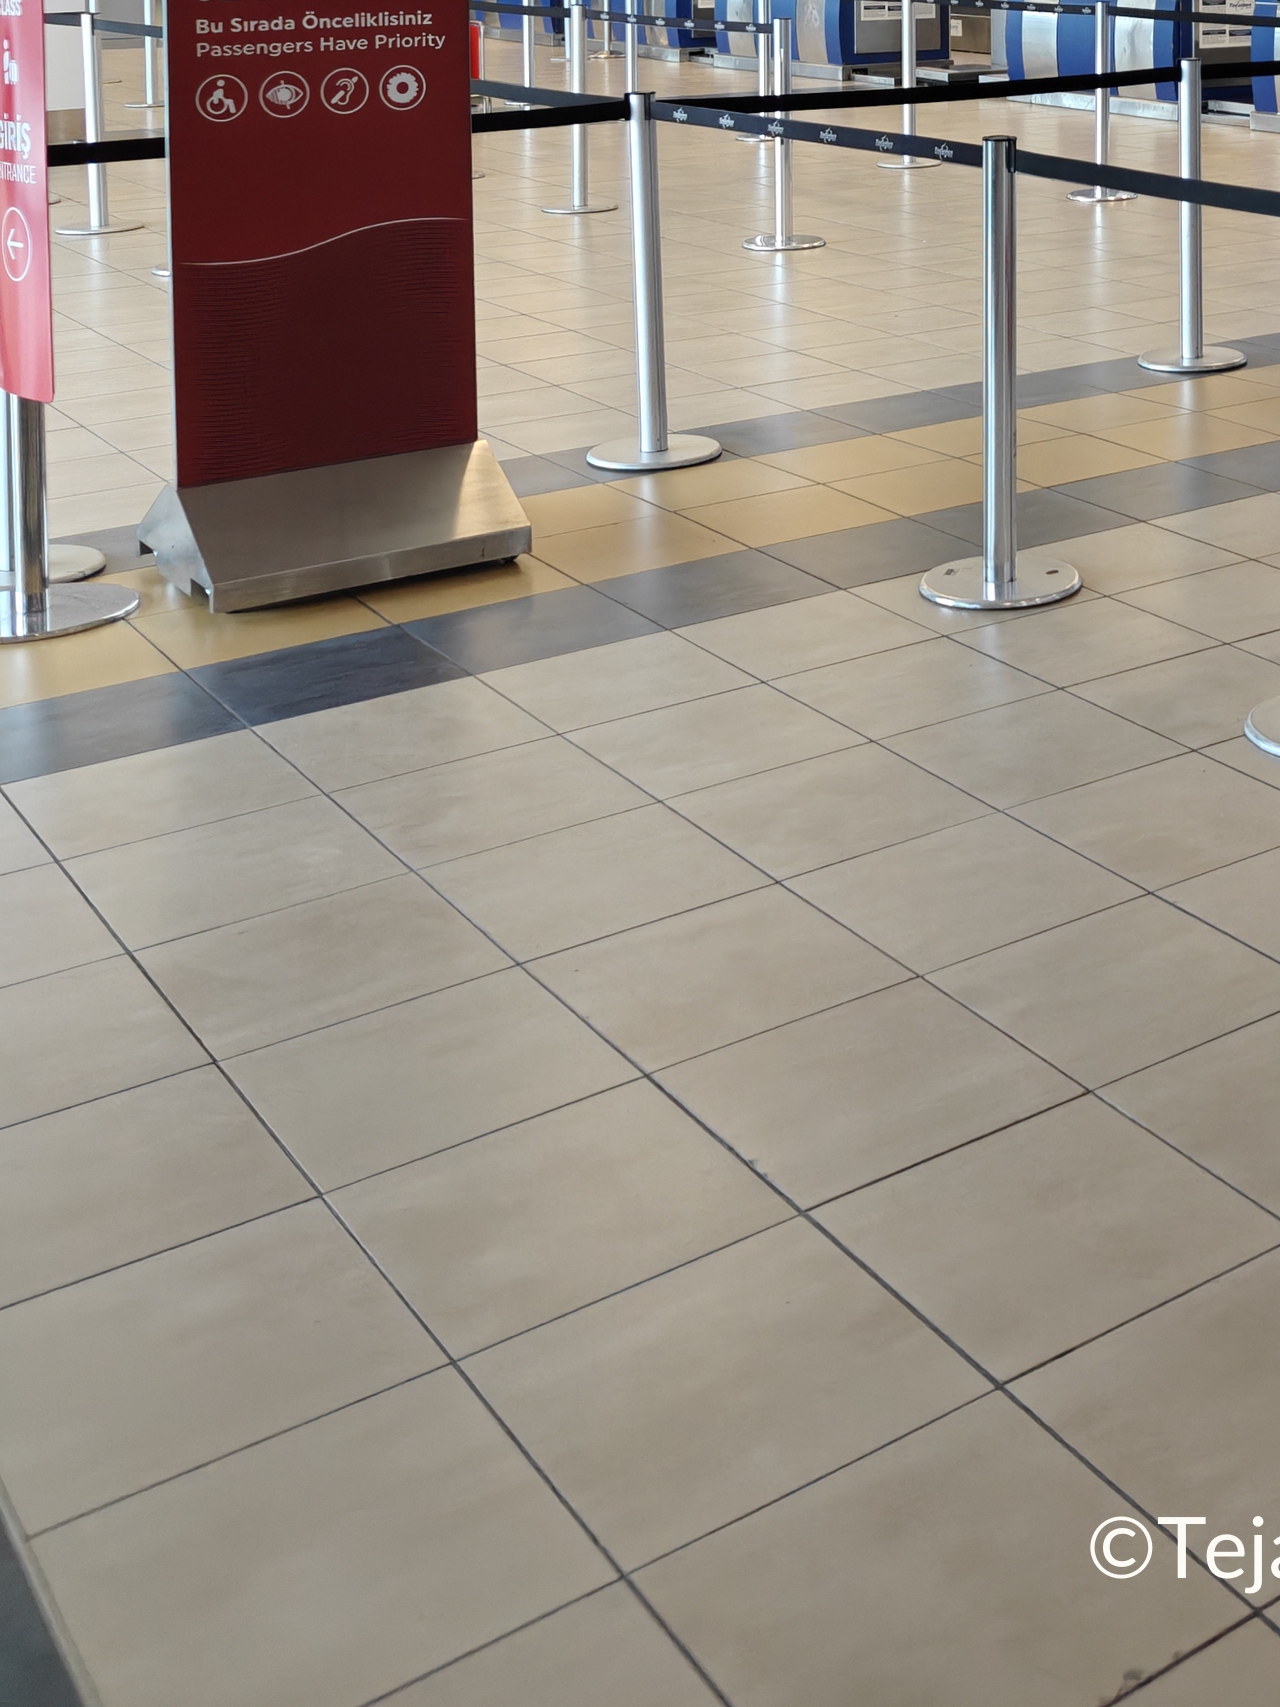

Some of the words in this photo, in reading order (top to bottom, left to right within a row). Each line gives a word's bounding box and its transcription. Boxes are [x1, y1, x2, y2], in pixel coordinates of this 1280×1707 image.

[196, 19, 223, 34] Bu
[230, 16, 296, 32] Sırada
[302, 11, 432, 29] Önceliklisiniz
[196, 40, 313, 57] Passengers
[320, 37, 368, 51] Have
[374, 32, 446, 49] Priority
